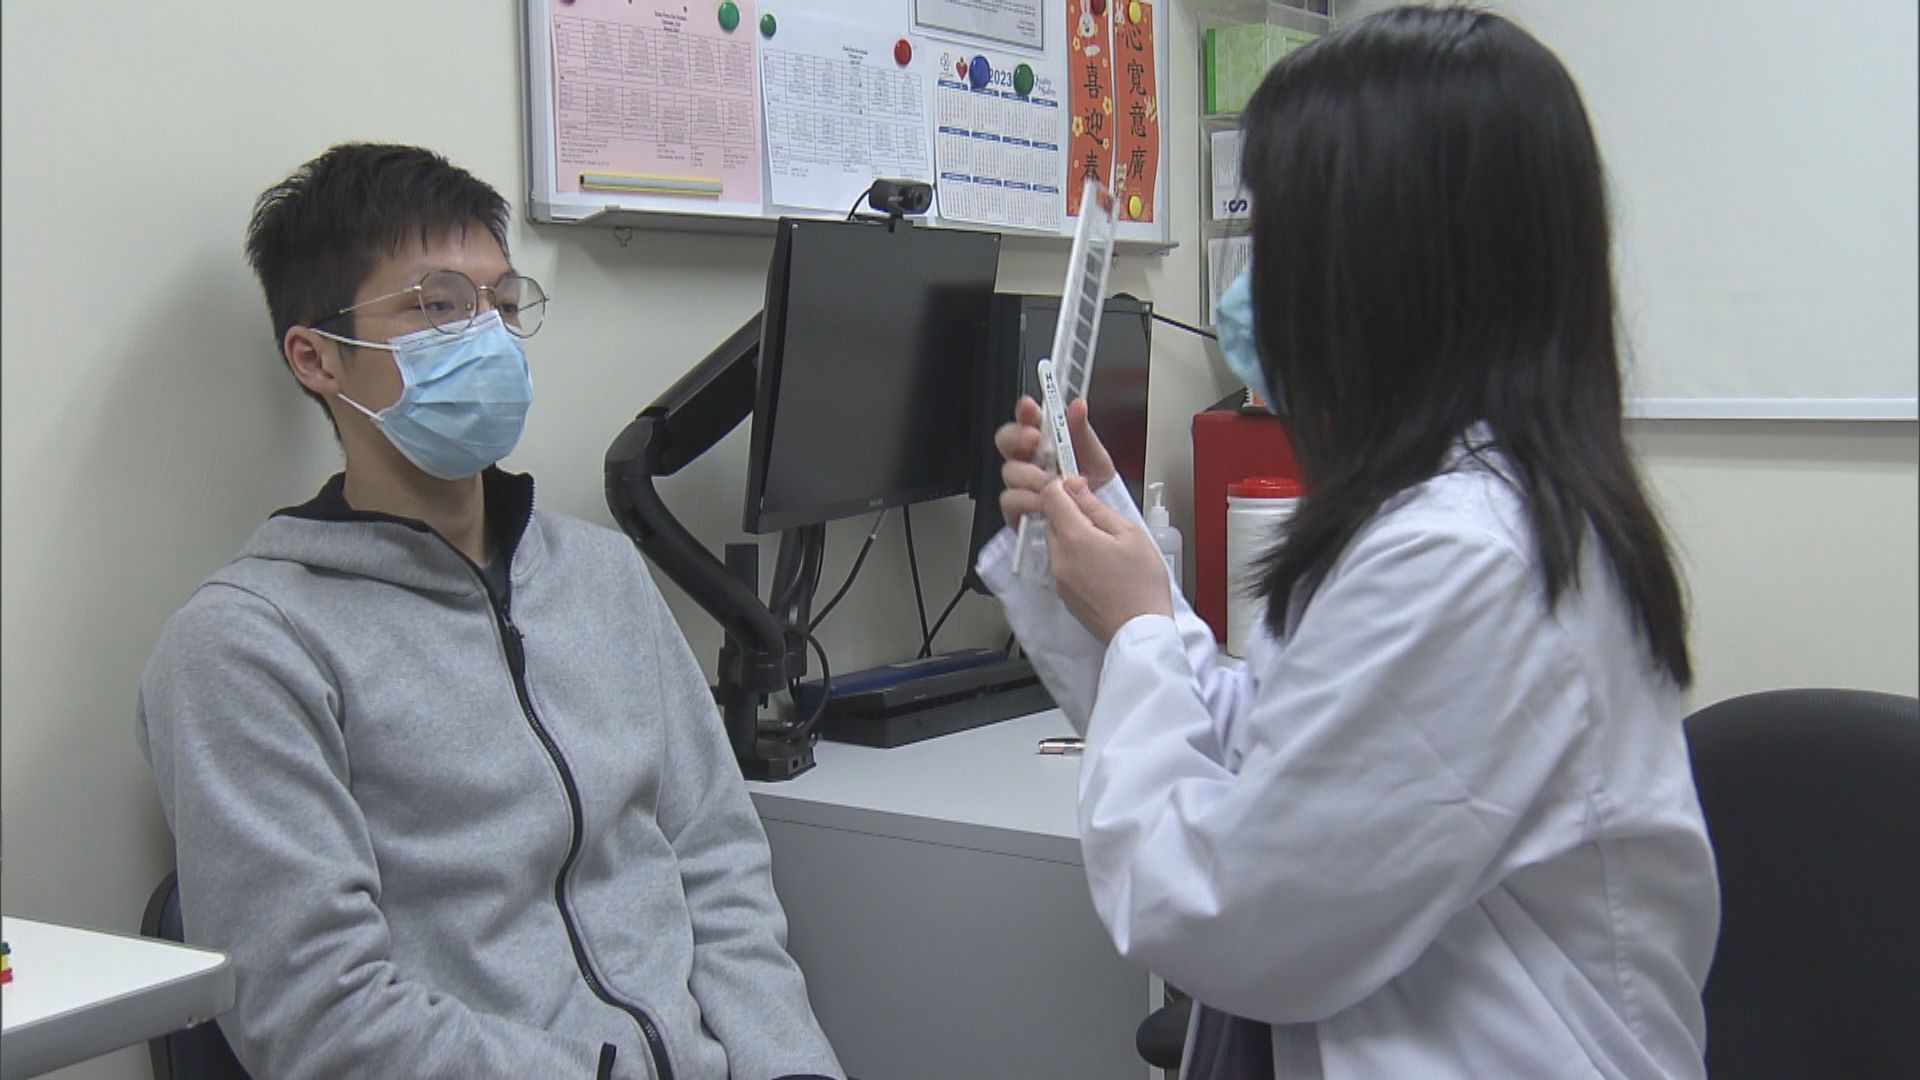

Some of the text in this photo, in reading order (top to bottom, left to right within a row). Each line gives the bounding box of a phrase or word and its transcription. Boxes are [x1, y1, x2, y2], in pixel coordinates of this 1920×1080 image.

[989, 68, 1012, 88] 2023
[1124, 27, 1148, 181] 心寬意廣
